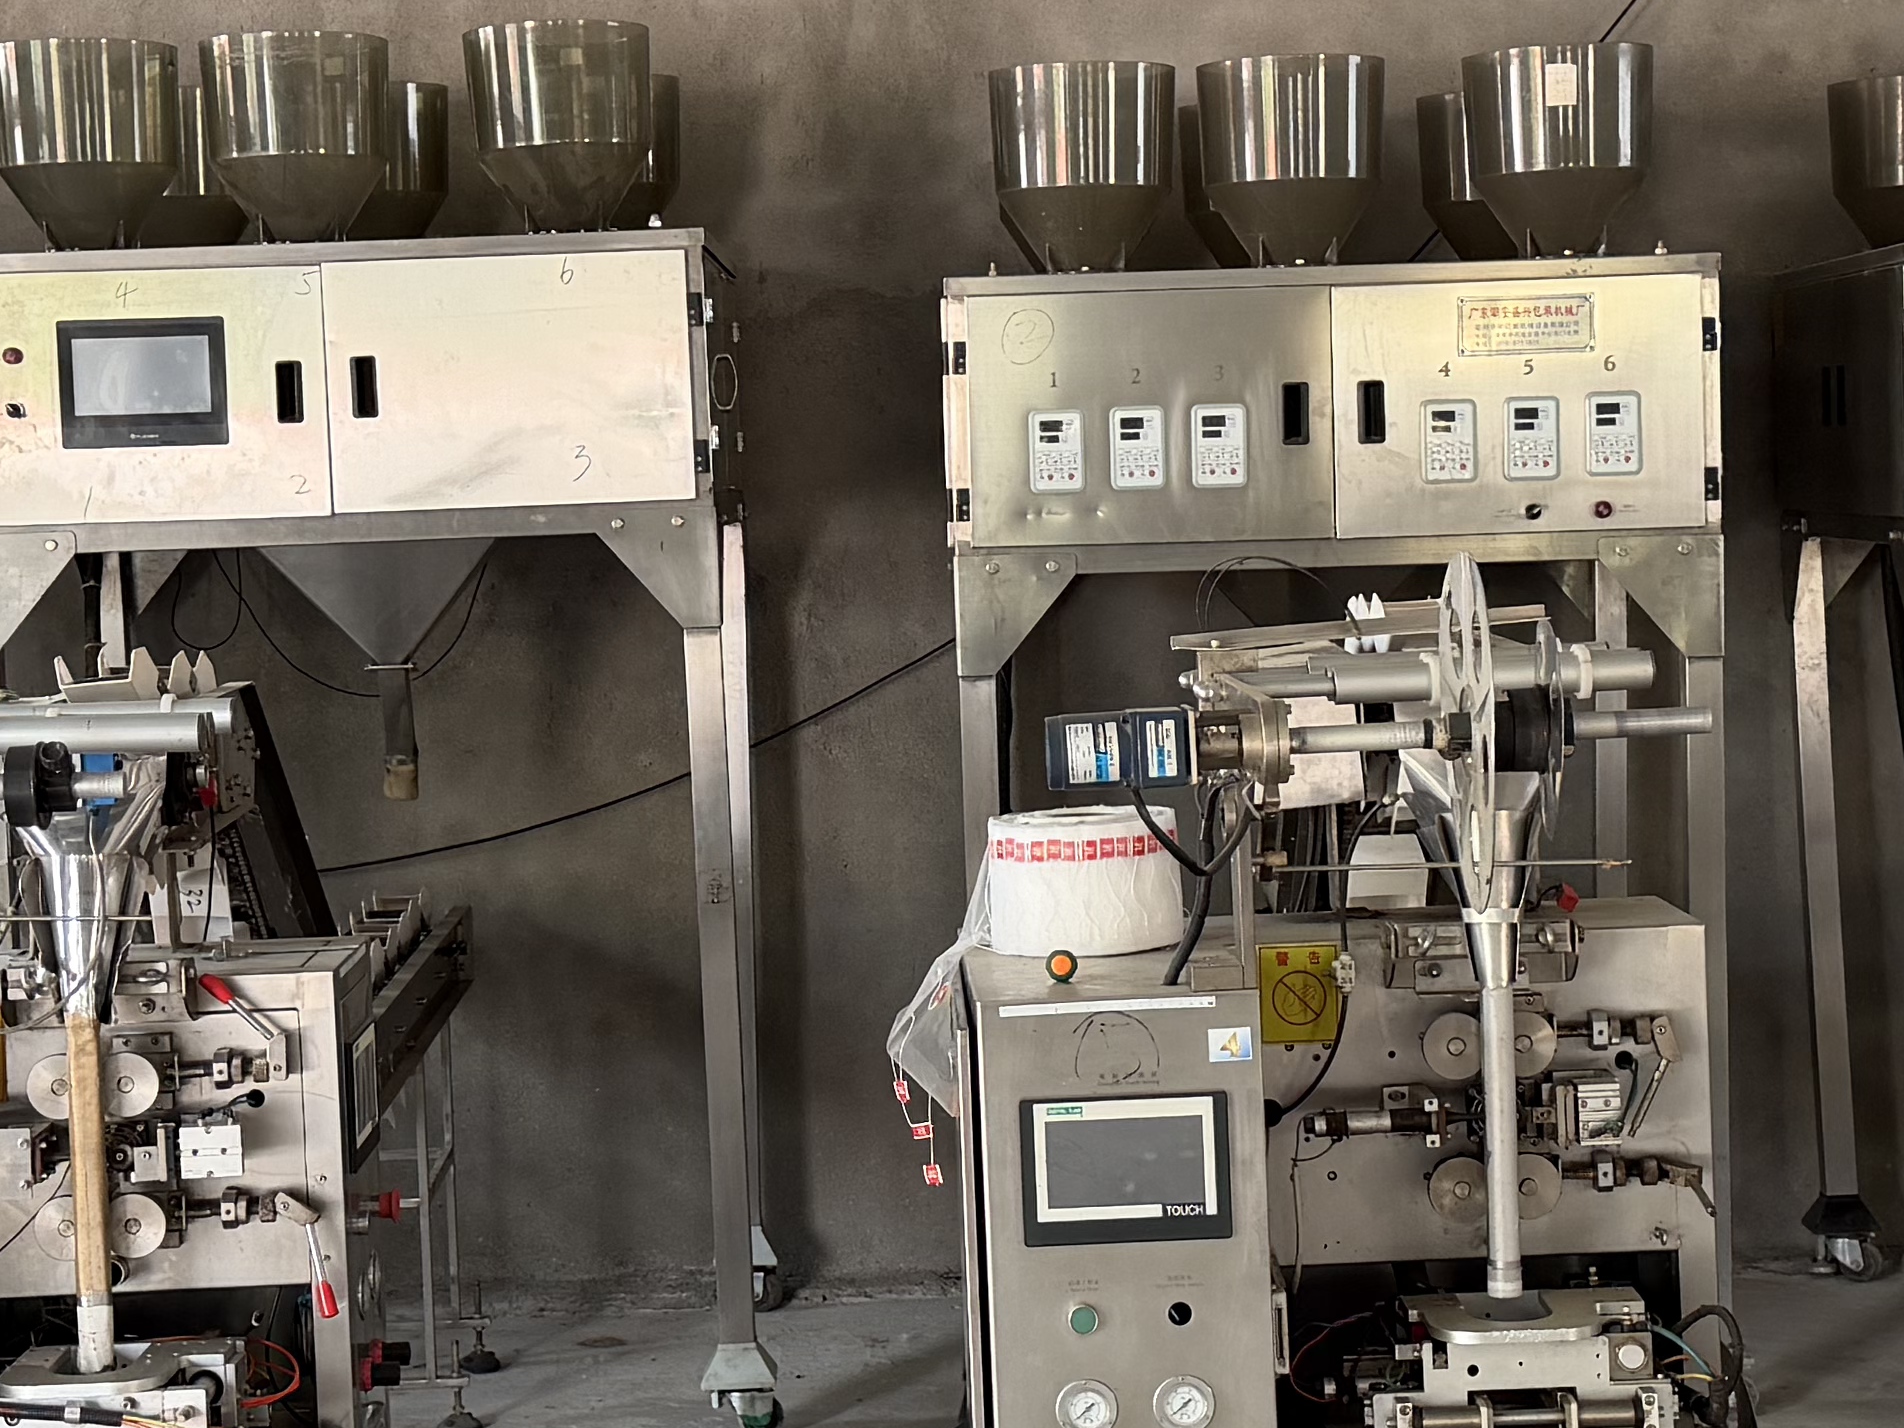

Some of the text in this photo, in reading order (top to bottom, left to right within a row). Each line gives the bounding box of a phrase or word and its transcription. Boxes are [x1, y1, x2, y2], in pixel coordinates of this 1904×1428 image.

[560, 256, 575, 285] 6
[115, 280, 140, 309] 4
[294, 269, 322, 296] 5
[1049, 354, 1617, 388] 1 2 3 4 5 6
[287, 474, 311, 495] 2
[572, 444, 593, 482] 3
[1165, 1204, 1205, 1217] TOUCH
